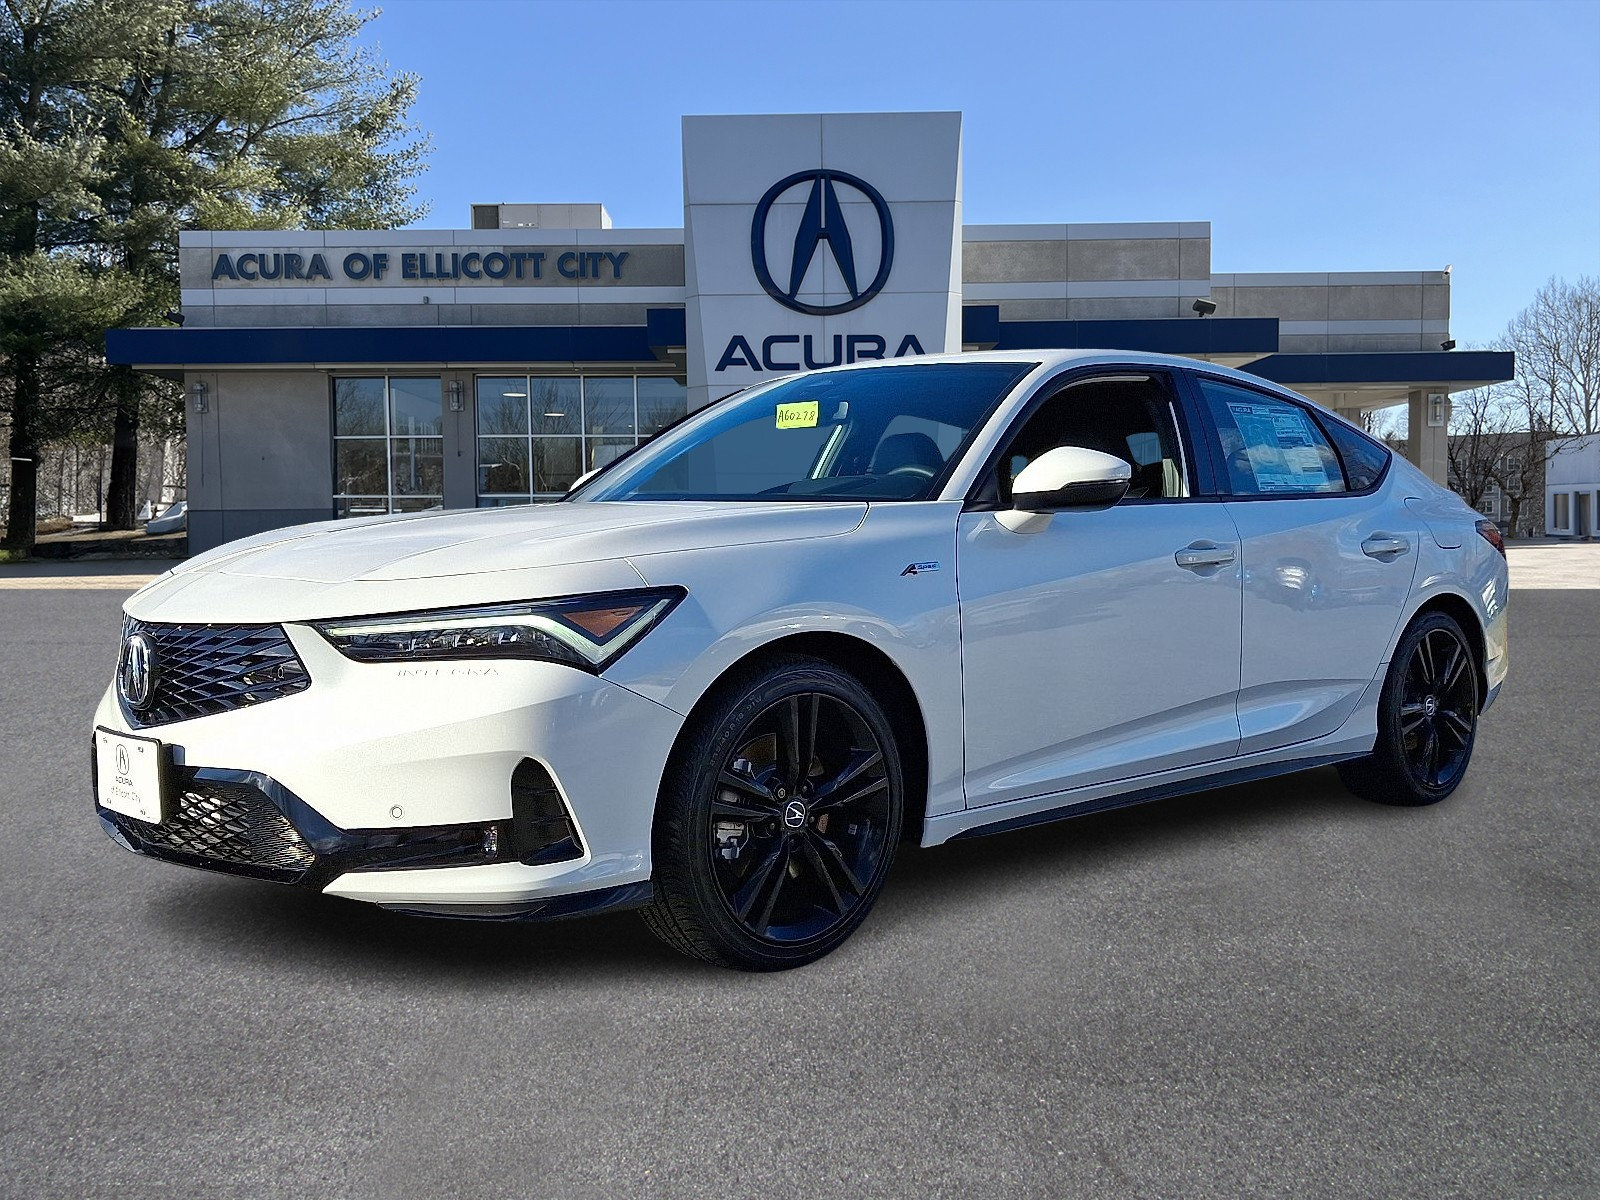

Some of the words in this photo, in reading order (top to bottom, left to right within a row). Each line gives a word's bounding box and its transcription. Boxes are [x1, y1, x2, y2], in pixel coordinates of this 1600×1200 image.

[211, 252, 332, 280] ACURA
[342, 252, 390, 280] OF
[401, 251, 547, 280] ELLICOTT
[556, 250, 630, 280] CITY
[778, 409, 815, 423] A60278
